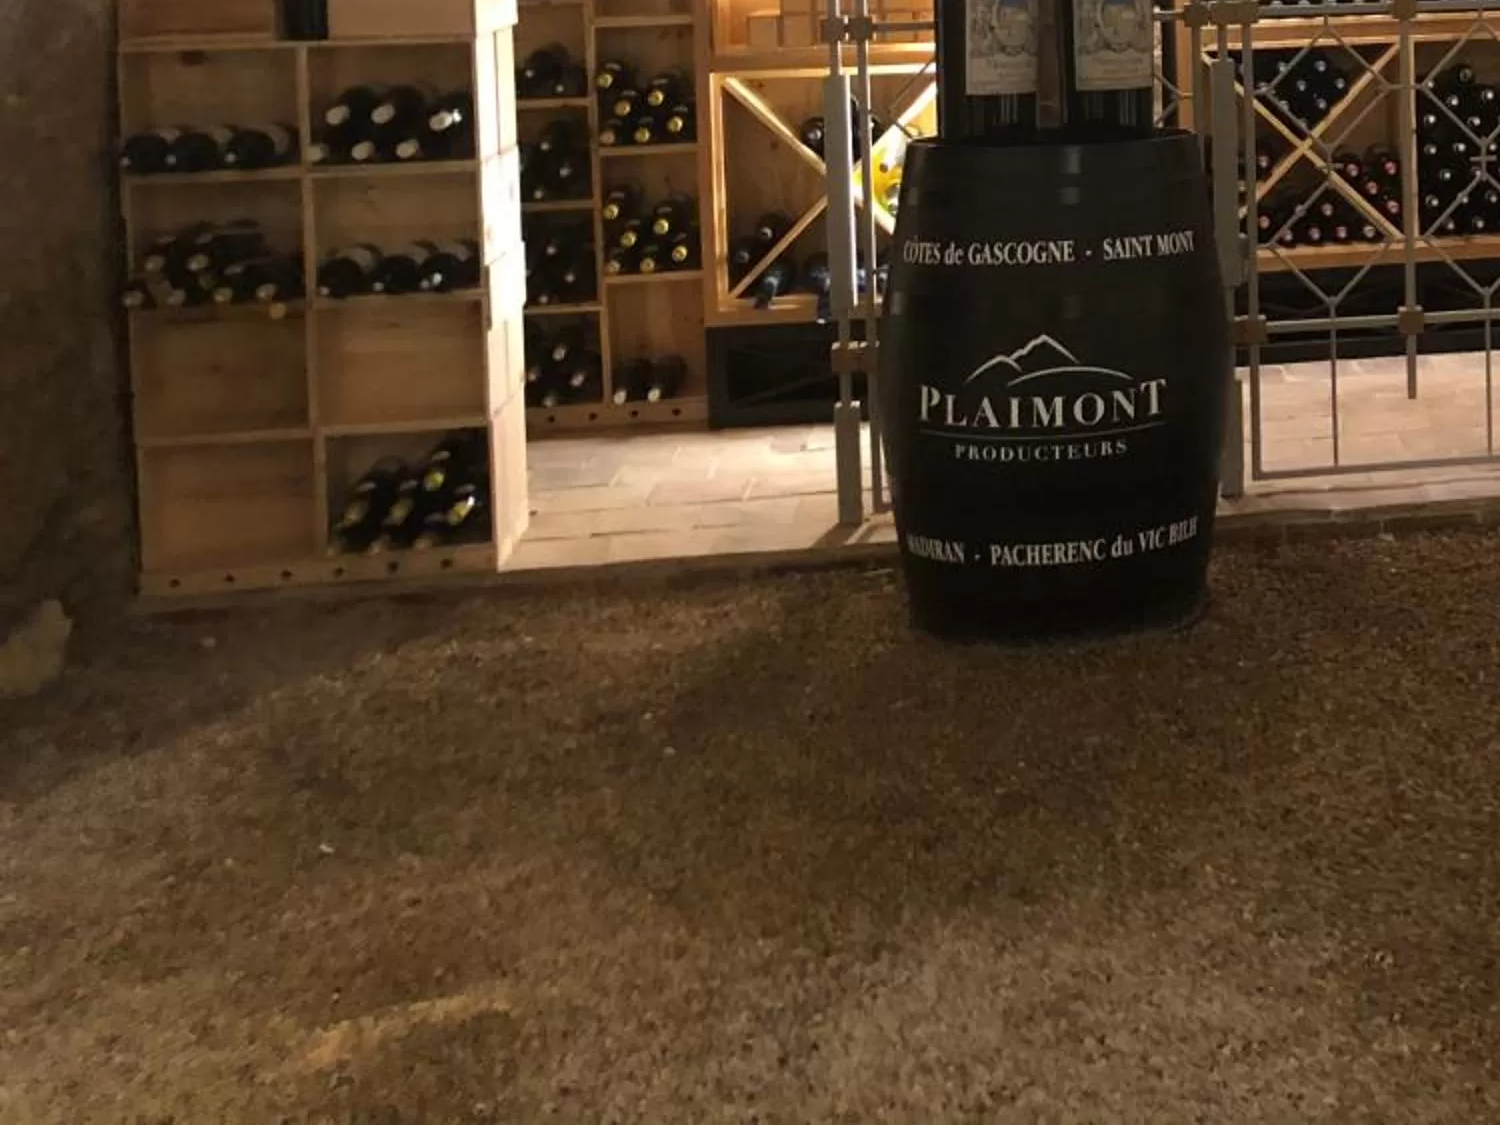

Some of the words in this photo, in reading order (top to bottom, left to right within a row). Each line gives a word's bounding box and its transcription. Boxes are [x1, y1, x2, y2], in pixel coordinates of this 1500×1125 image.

[944, 243, 964, 265] de
[968, 239, 1076, 266] GASCOGNE
[1103, 234, 1152, 260] SAINT
[1157, 230, 1194, 256] MONT
[919, 378, 1167, 428] PLAIMONT
[954, 438, 1128, 462] PRODUCTEURS
[990, 539, 1107, 566] PACHERENC
[1111, 535, 1133, 558] du
[1138, 527, 1166, 552] VIC
